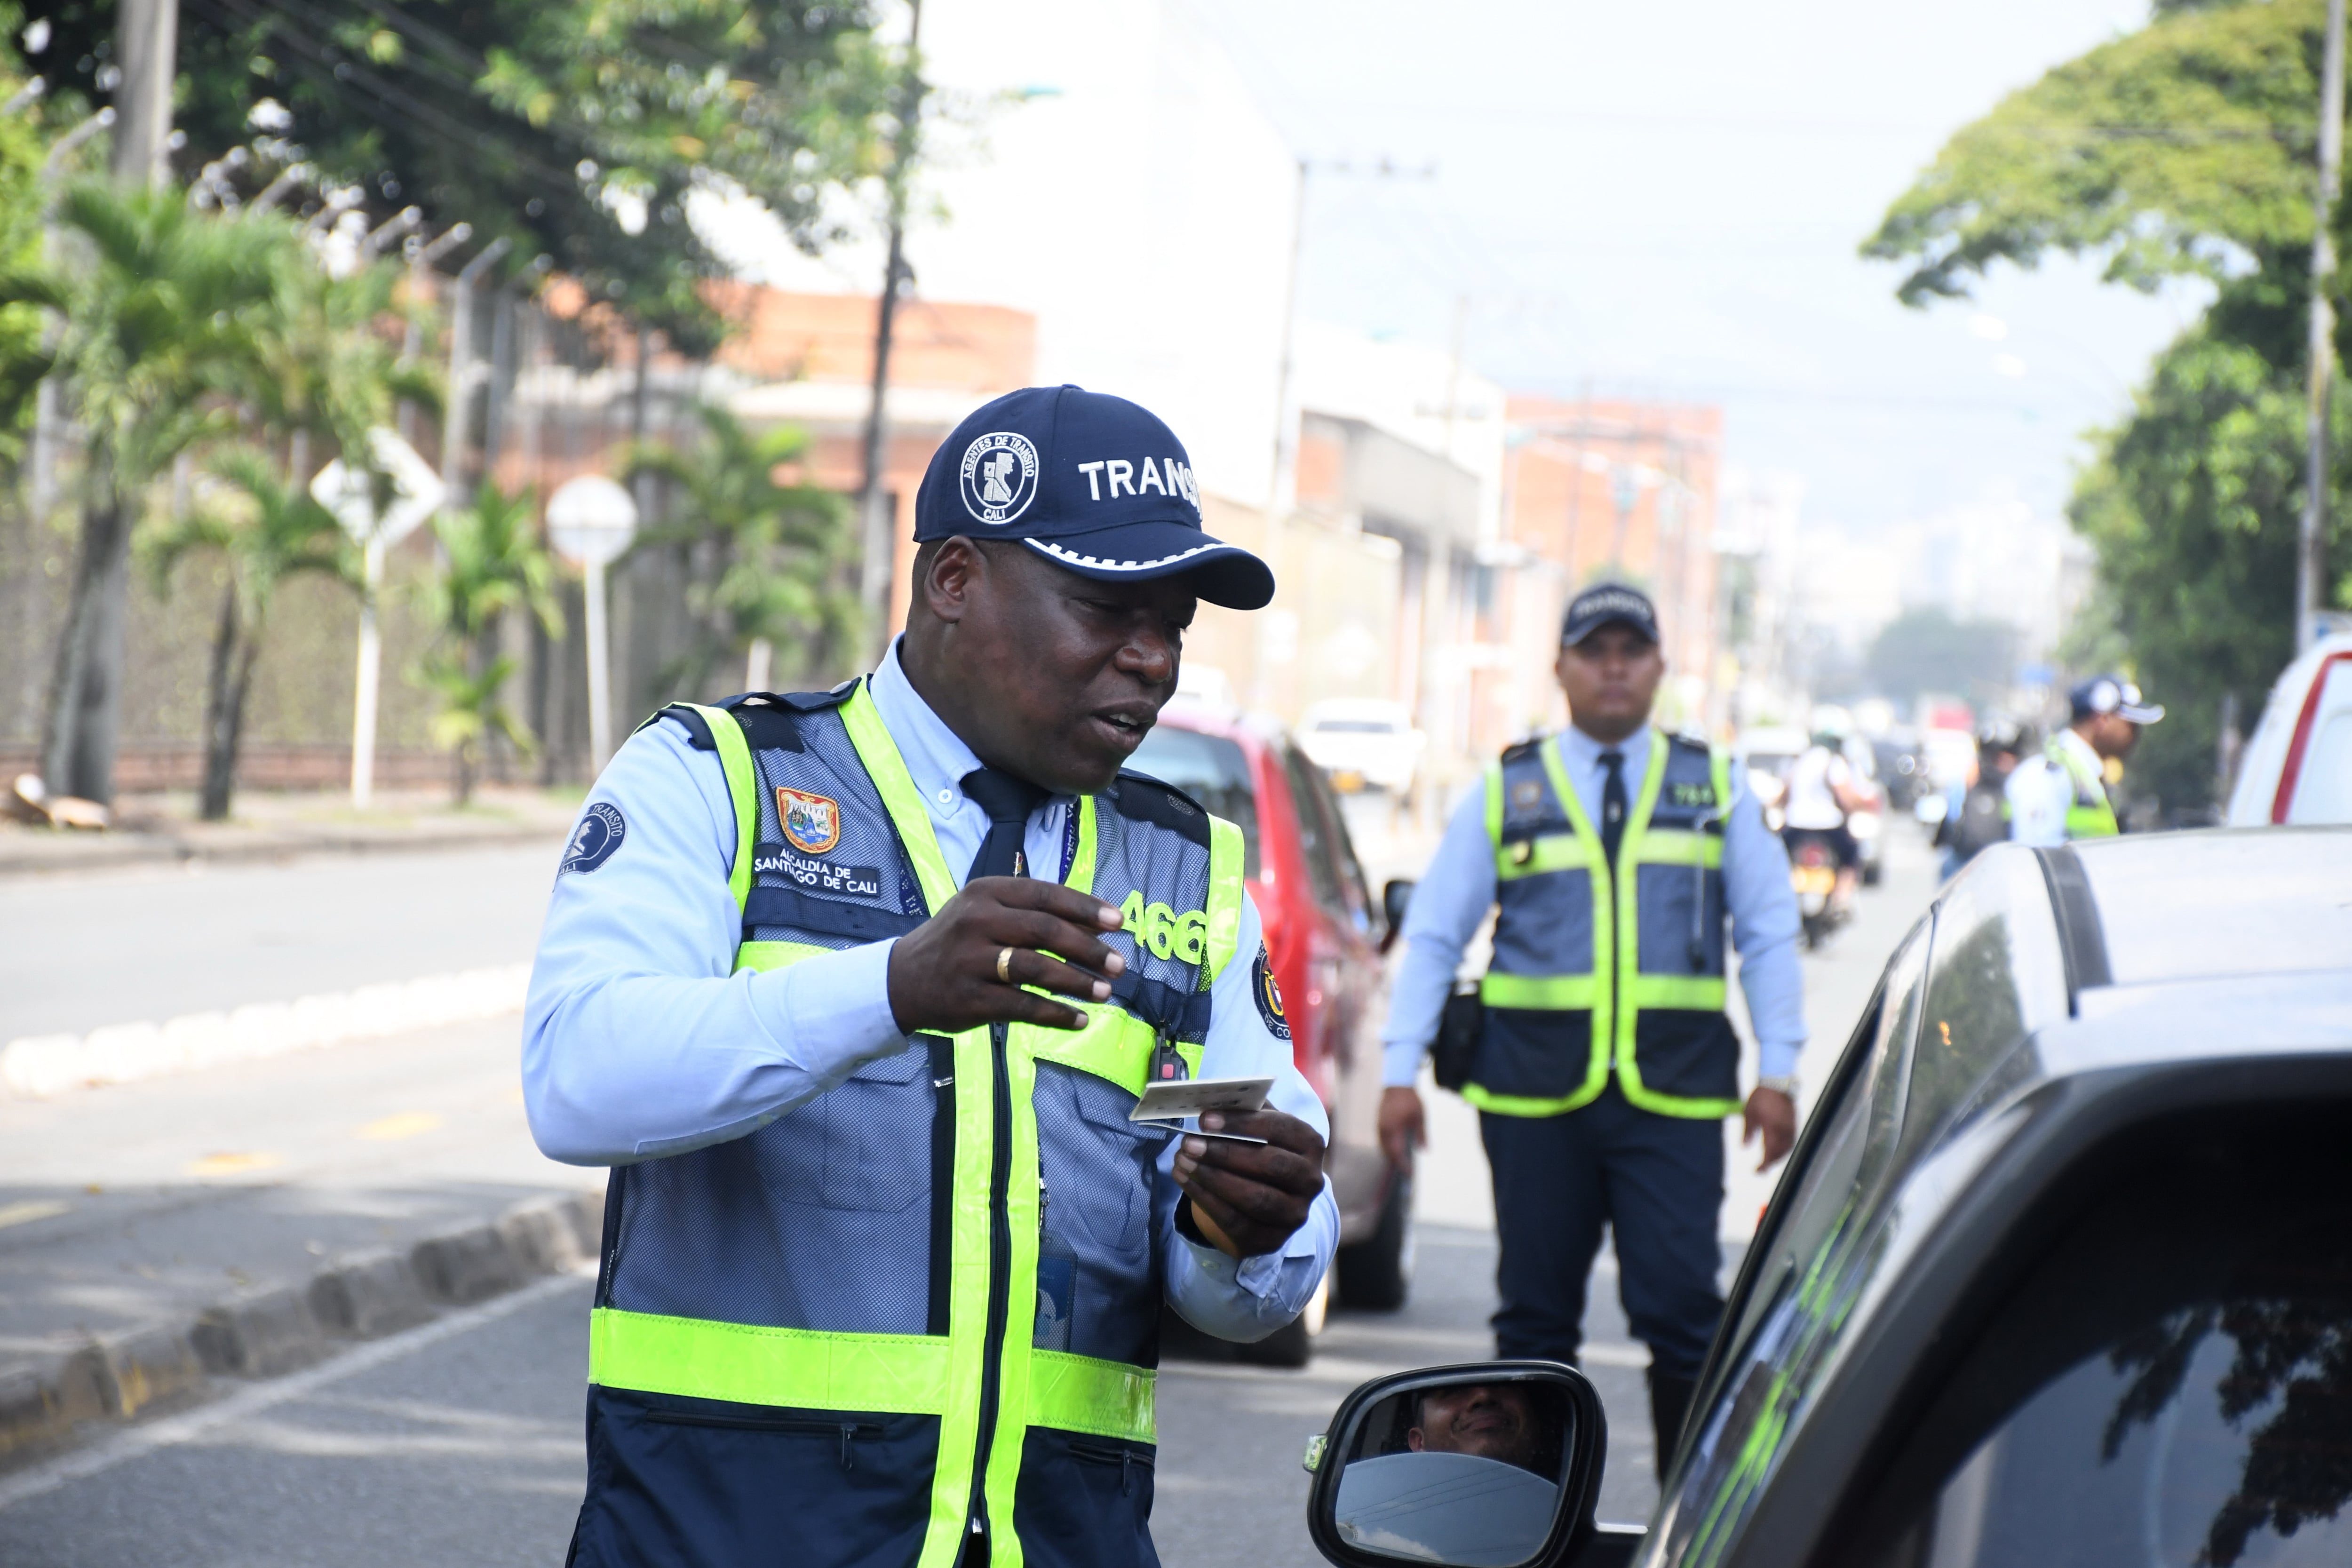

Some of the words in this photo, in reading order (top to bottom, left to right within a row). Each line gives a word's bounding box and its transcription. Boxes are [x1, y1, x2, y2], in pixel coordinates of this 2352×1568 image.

[964, 438, 992, 479] AGENTES
[995, 436, 1009, 446] DE
[1009, 437, 1035, 477] TRANSITO
[1078, 456, 1202, 522] TRANS
[983, 508, 1006, 521] CALI
[592, 804, 623, 837] TRANSITO
[754, 857, 817, 885] SANTIAGO
[824, 876, 841, 889] DE
[846, 881, 877, 893] CALI
[835, 867, 850, 879] DE
[1120, 890, 1208, 965] 466
[1264, 1013, 1274, 1030] DE
